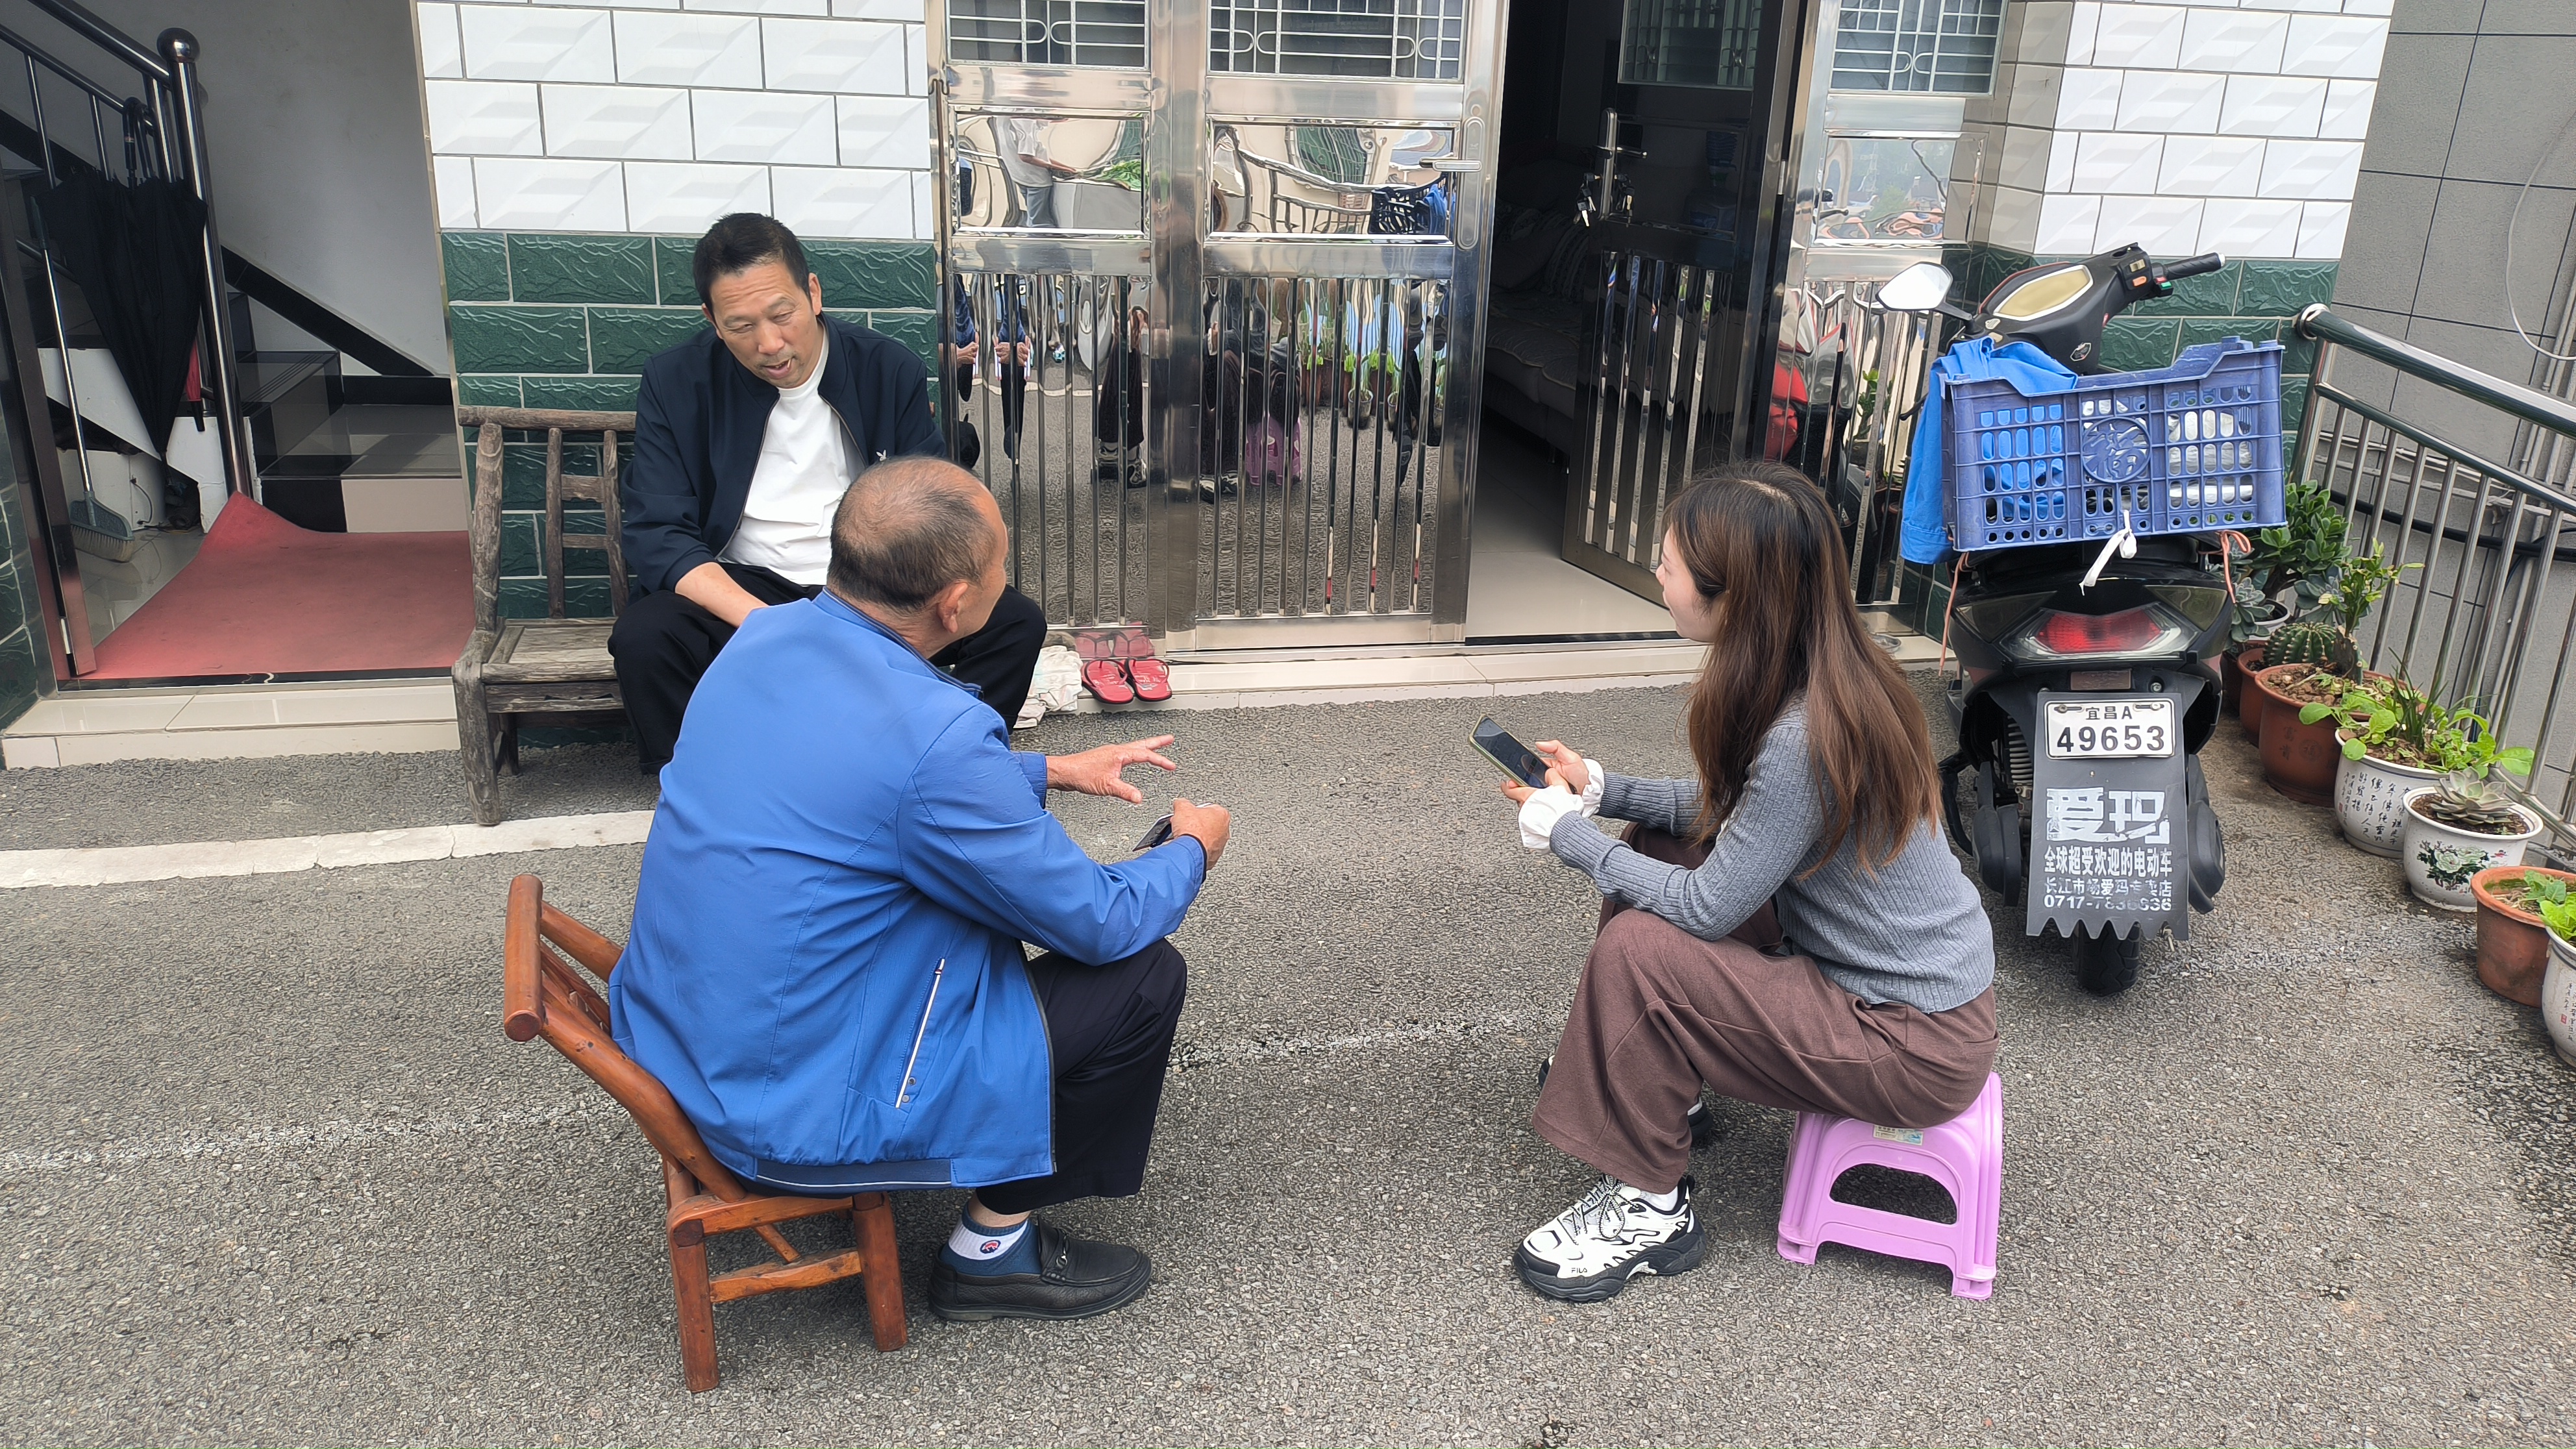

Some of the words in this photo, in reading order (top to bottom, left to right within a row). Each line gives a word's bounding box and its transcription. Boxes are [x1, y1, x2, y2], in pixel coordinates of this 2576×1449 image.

[2085, 706, 2133, 720] 宜昌A
[2057, 725, 2164, 752] 49653
[2044, 845, 2172, 878] 全球超受欢迎的电动车
